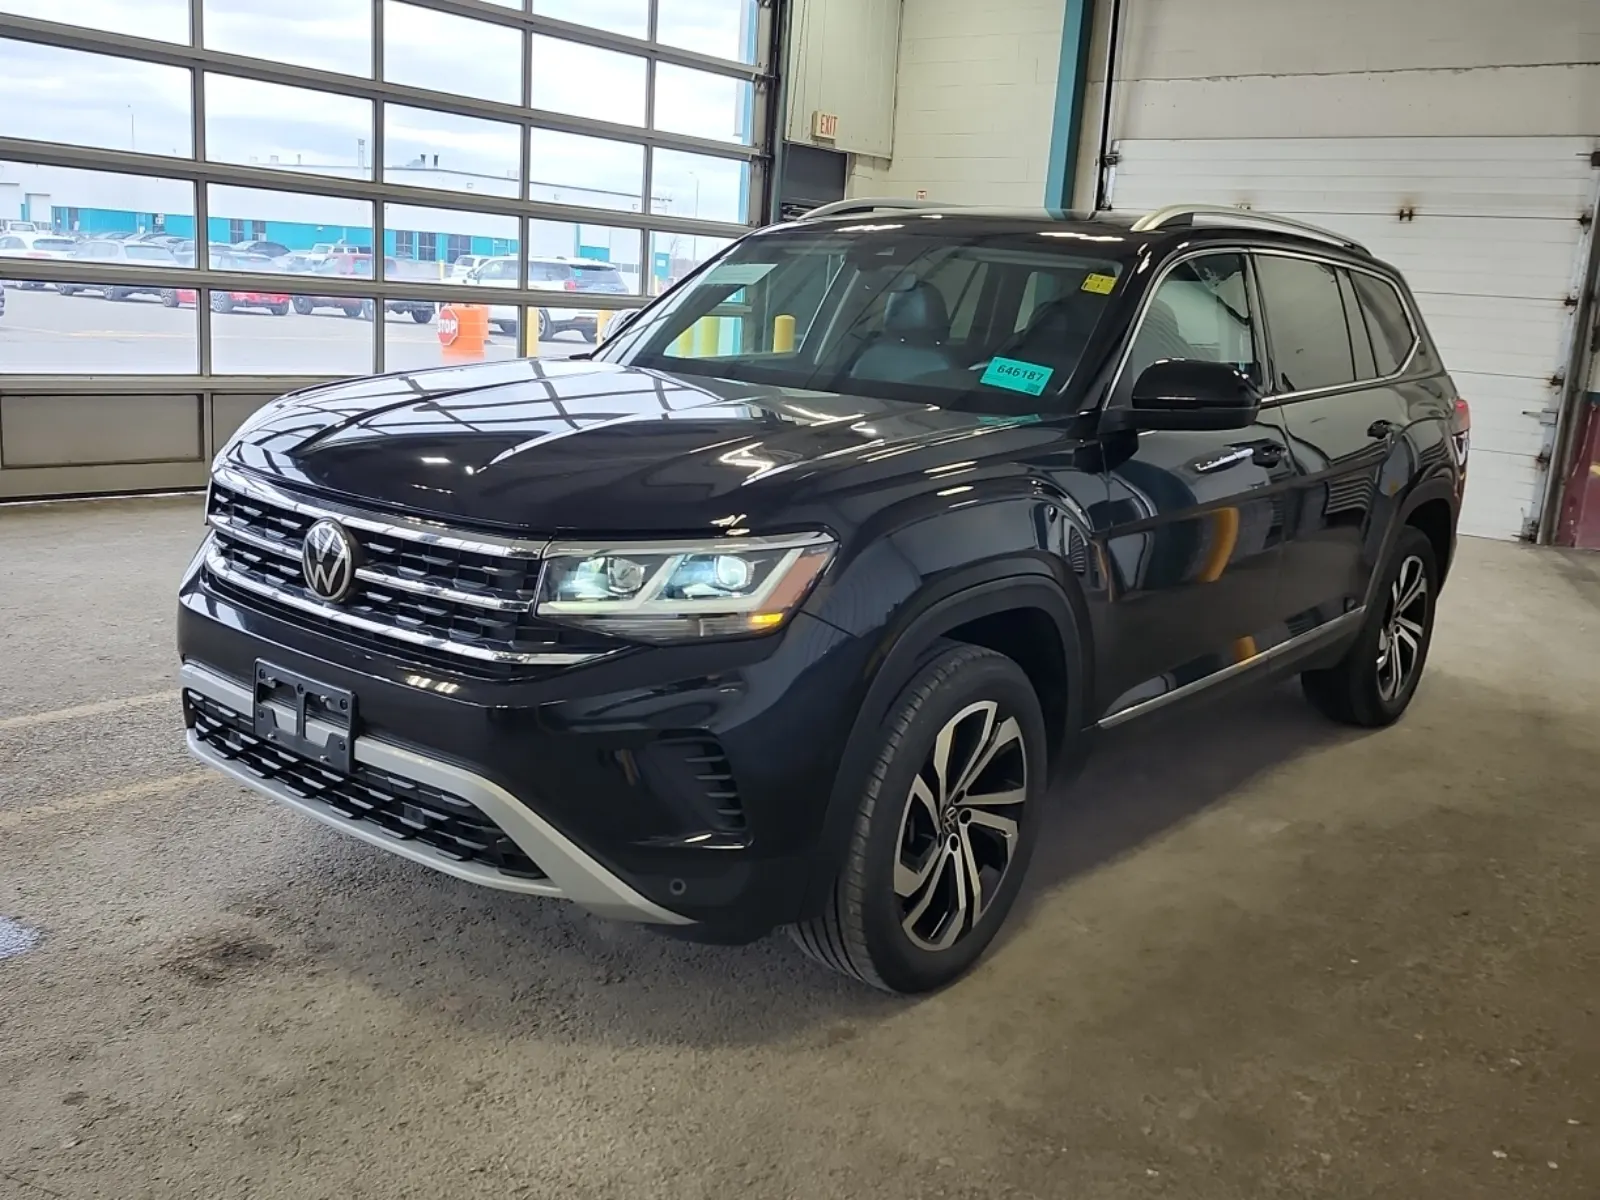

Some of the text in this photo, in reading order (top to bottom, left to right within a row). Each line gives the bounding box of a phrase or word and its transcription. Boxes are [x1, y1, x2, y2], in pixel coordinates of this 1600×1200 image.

[820, 114, 838, 135] EXIT
[438, 318, 457, 334] STOP
[996, 364, 1044, 382] 646187
